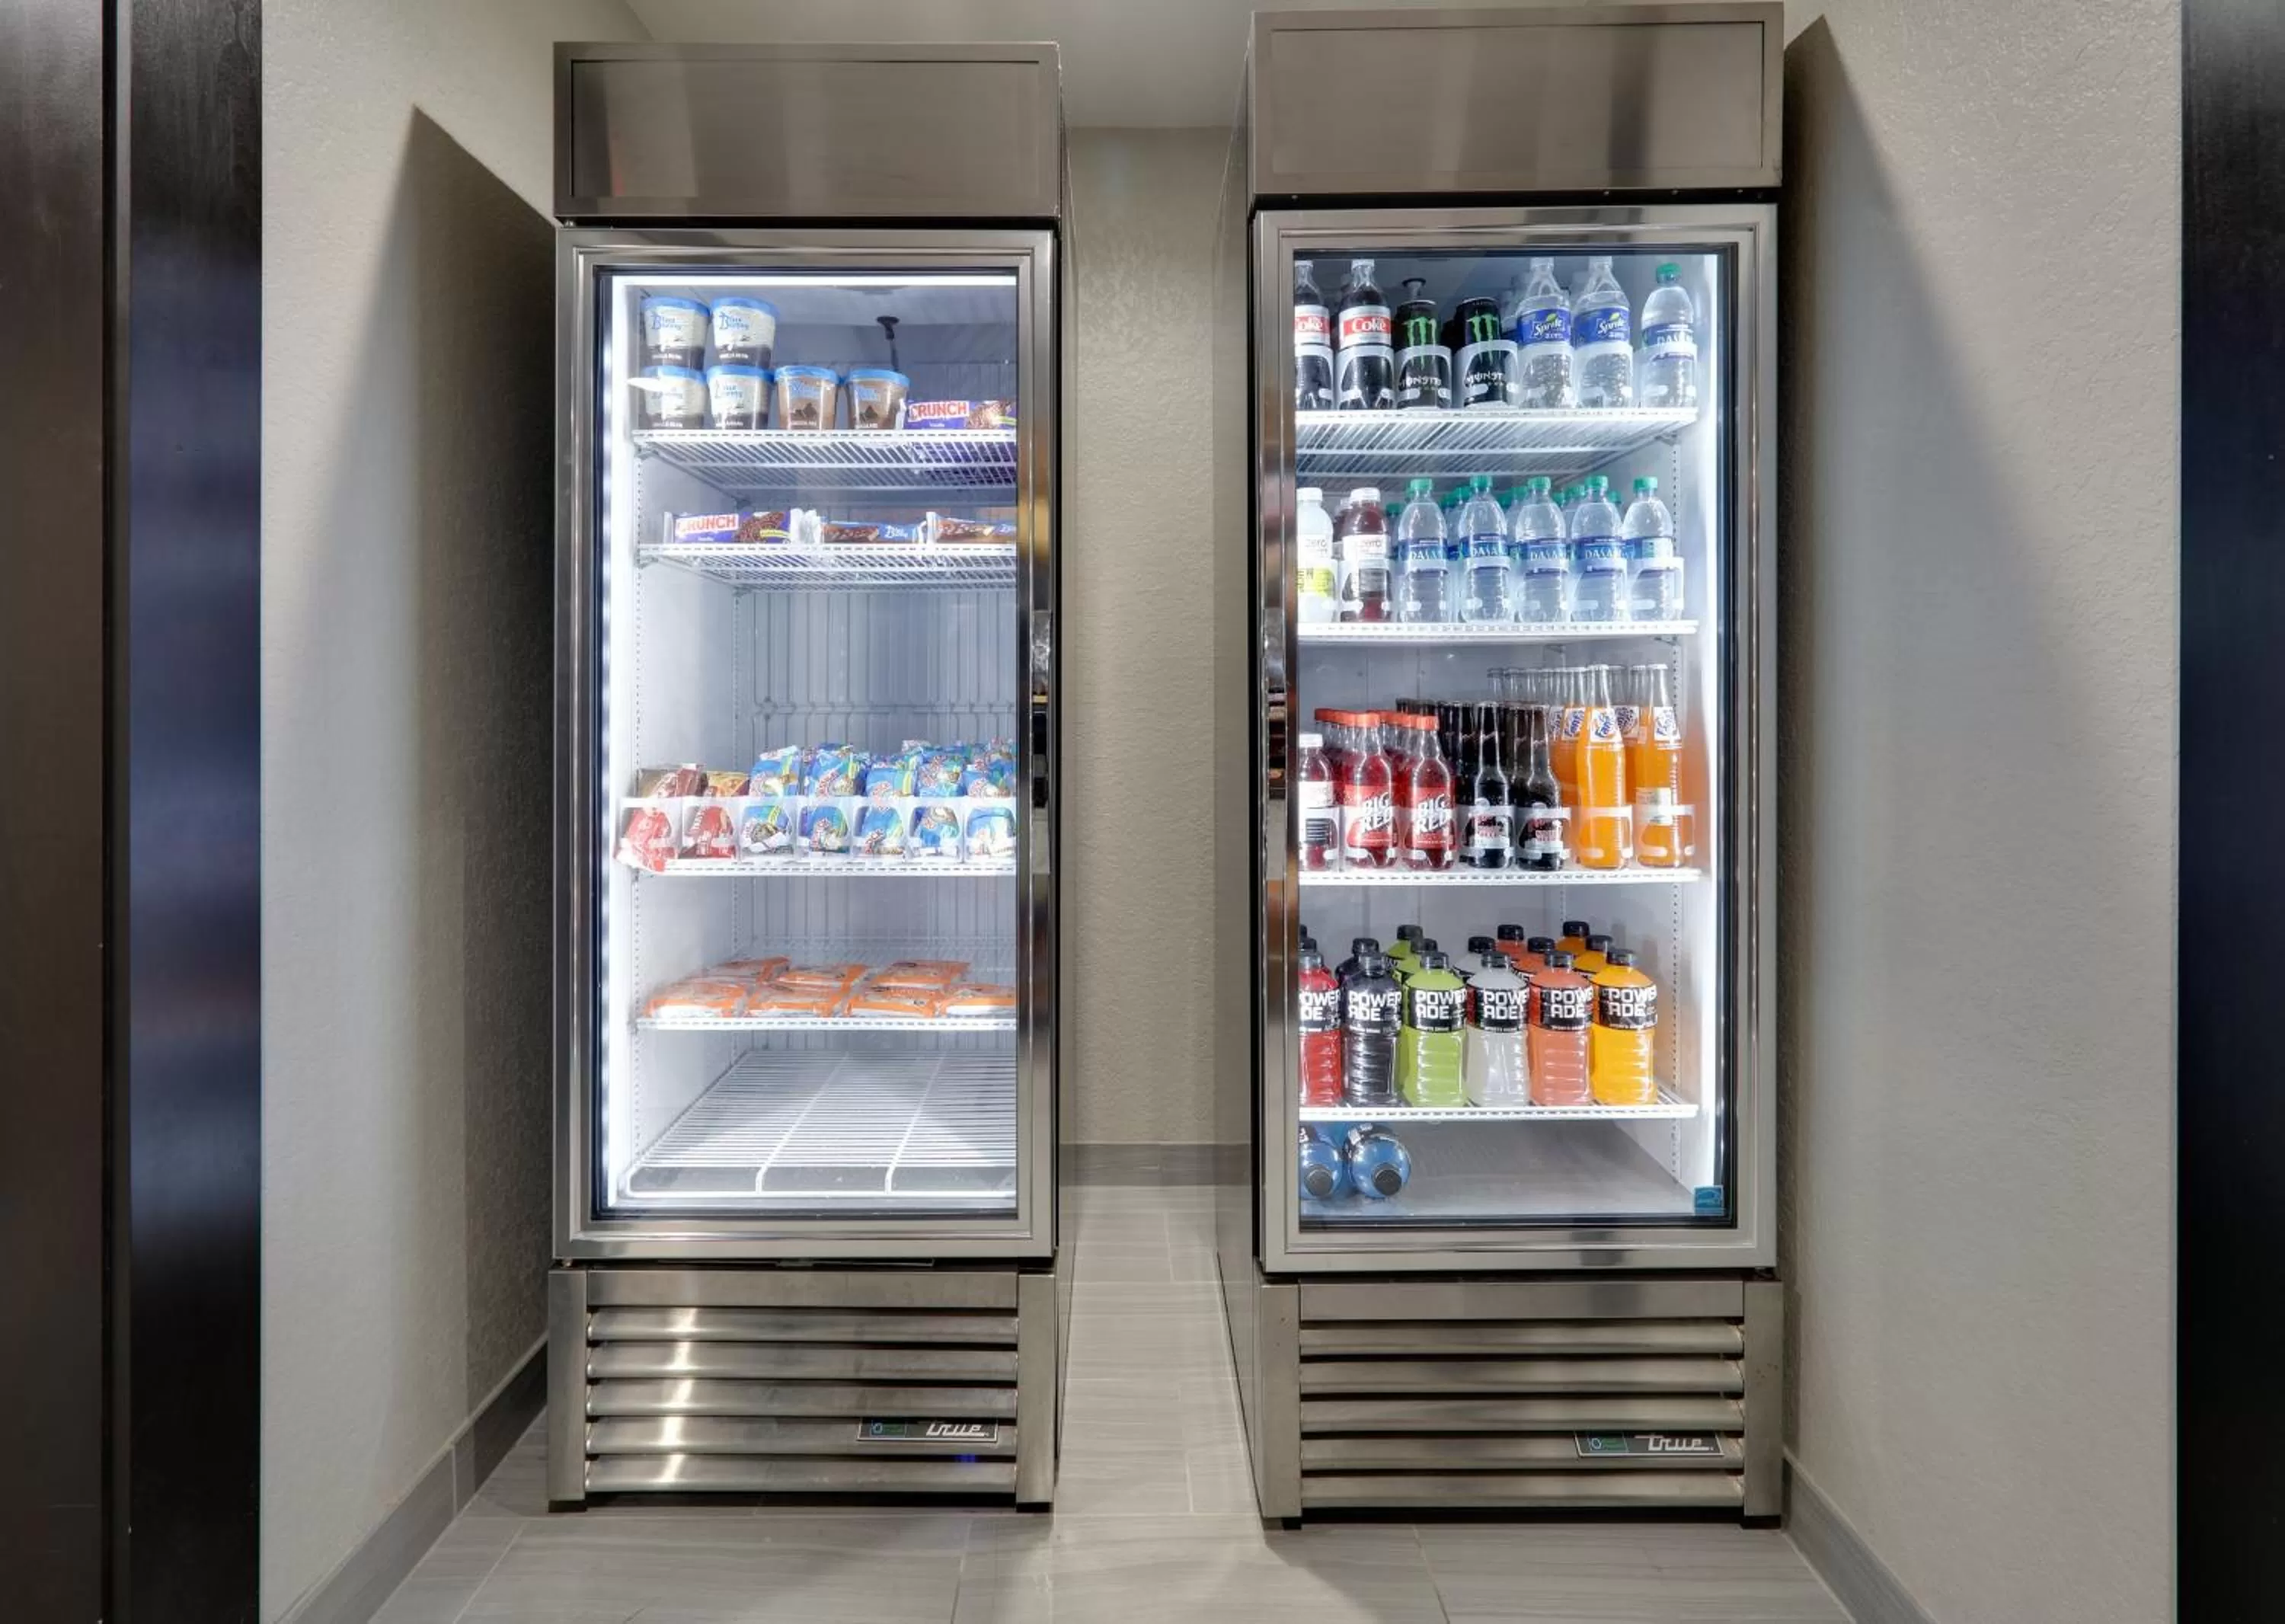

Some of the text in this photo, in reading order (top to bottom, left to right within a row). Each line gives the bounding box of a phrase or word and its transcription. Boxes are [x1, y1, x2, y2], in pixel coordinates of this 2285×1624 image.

[1352, 317, 1386, 332] Coke
[1533, 318, 1563, 337] Sprite
[910, 402, 967, 421] CRUNCH
[1362, 792, 1390, 817] BIG
[1417, 794, 1446, 820] BIG
[1359, 808, 1392, 833] RED
[1417, 808, 1452, 833] RED
[1299, 989, 1341, 1006] OWER
[1348, 990, 1401, 1008] POWER
[1415, 988, 1468, 1005] POWER
[1483, 988, 1530, 1005] POWE
[1550, 985, 1594, 1005] POWE
[1608, 984, 1657, 1003] POWE
[1301, 1005, 1324, 1021] DE
[1348, 1005, 1381, 1021] ADE
[1415, 1003, 1450, 1019] ADE
[1483, 1005, 1518, 1020] ADE
[1550, 1003, 1585, 1018] ADE
[1608, 1001, 1647, 1017] ADE
